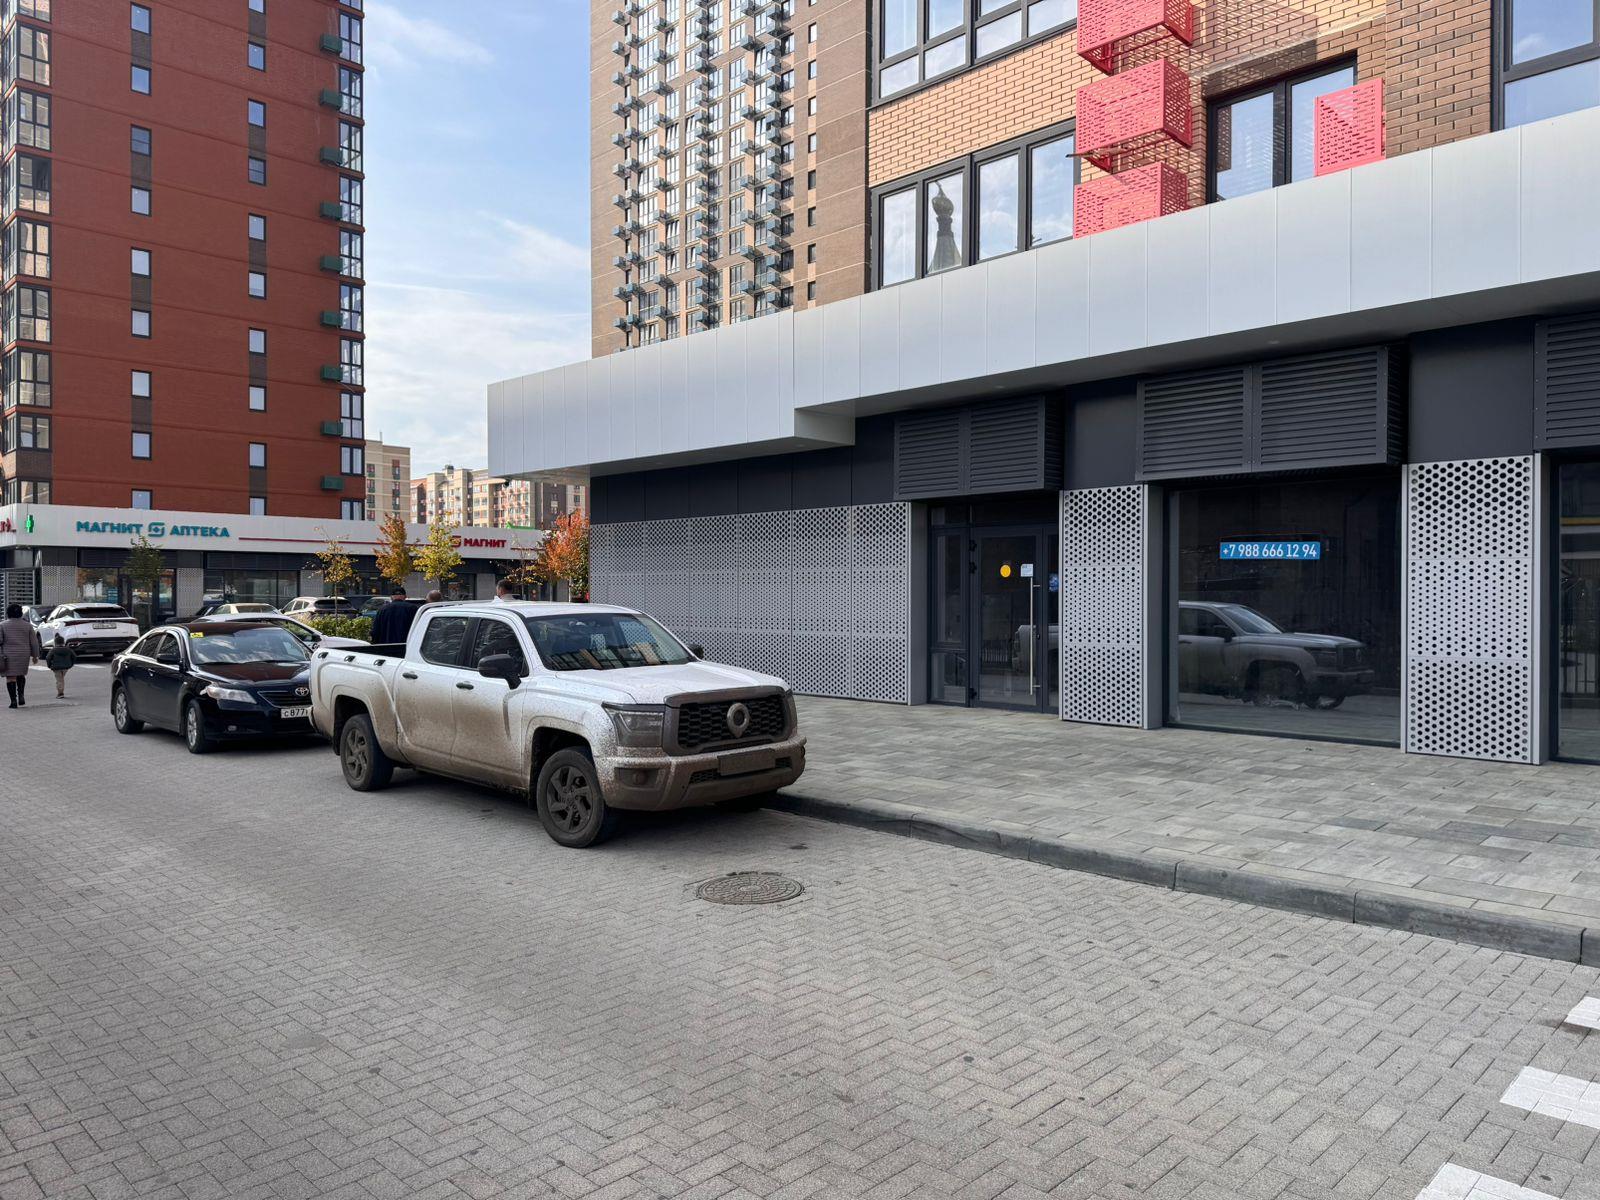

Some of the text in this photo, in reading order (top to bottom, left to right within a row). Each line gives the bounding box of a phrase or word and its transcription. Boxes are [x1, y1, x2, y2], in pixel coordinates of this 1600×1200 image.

[76, 520, 230, 537] МАГНИТ АПТЕКА
[463, 538, 507, 548] МАГНИТ
[1223, 544, 1317, 558] +7 988 666 12 94
